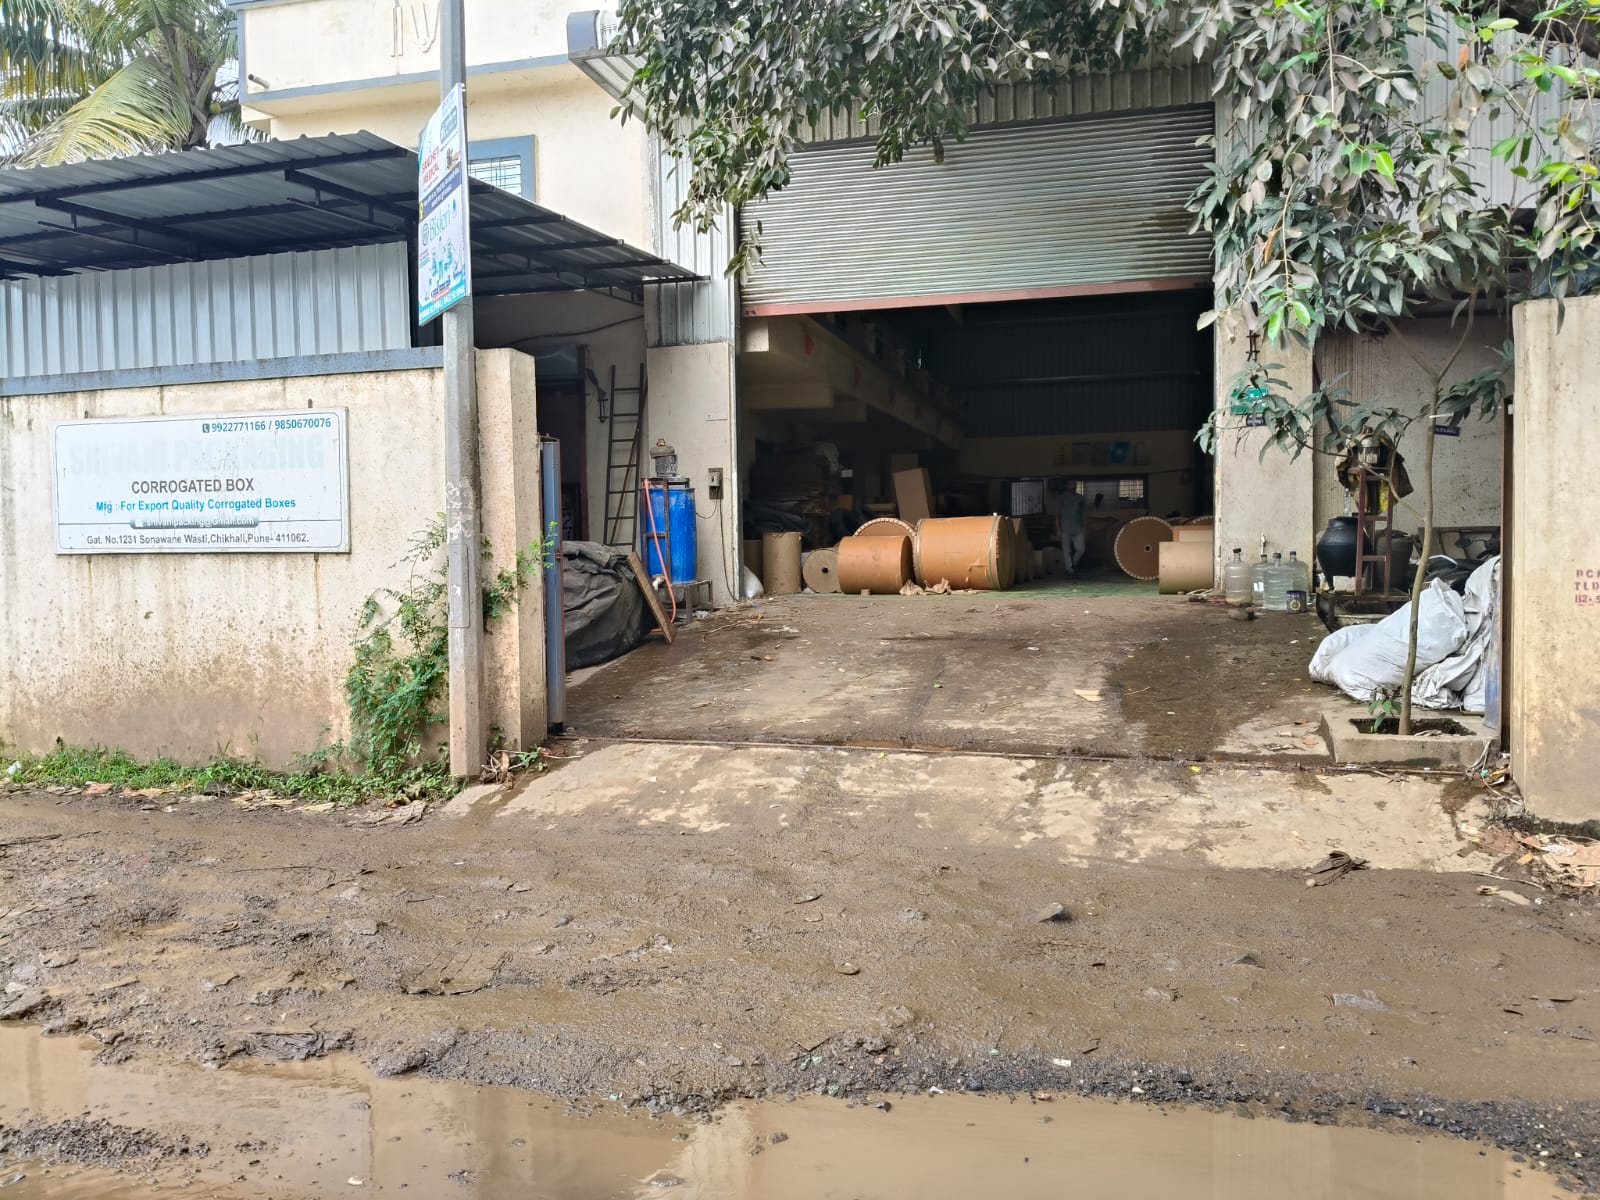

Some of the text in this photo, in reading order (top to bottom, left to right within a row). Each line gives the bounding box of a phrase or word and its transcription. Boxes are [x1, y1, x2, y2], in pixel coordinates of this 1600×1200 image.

[211, 420, 266, 432] 9922771166
[274, 417, 331, 430] 9850670076
[131, 478, 255, 494] CORROGATED BOX
[120, 501, 135, 511] For
[138, 501, 169, 512] Export
[171, 499, 205, 512] Quality
[207, 498, 262, 511] Corrogated
[265, 497, 297, 508] Boxes
[105, 535, 137, 544] No.1231
[139, 534, 182, 544] Sonawane
